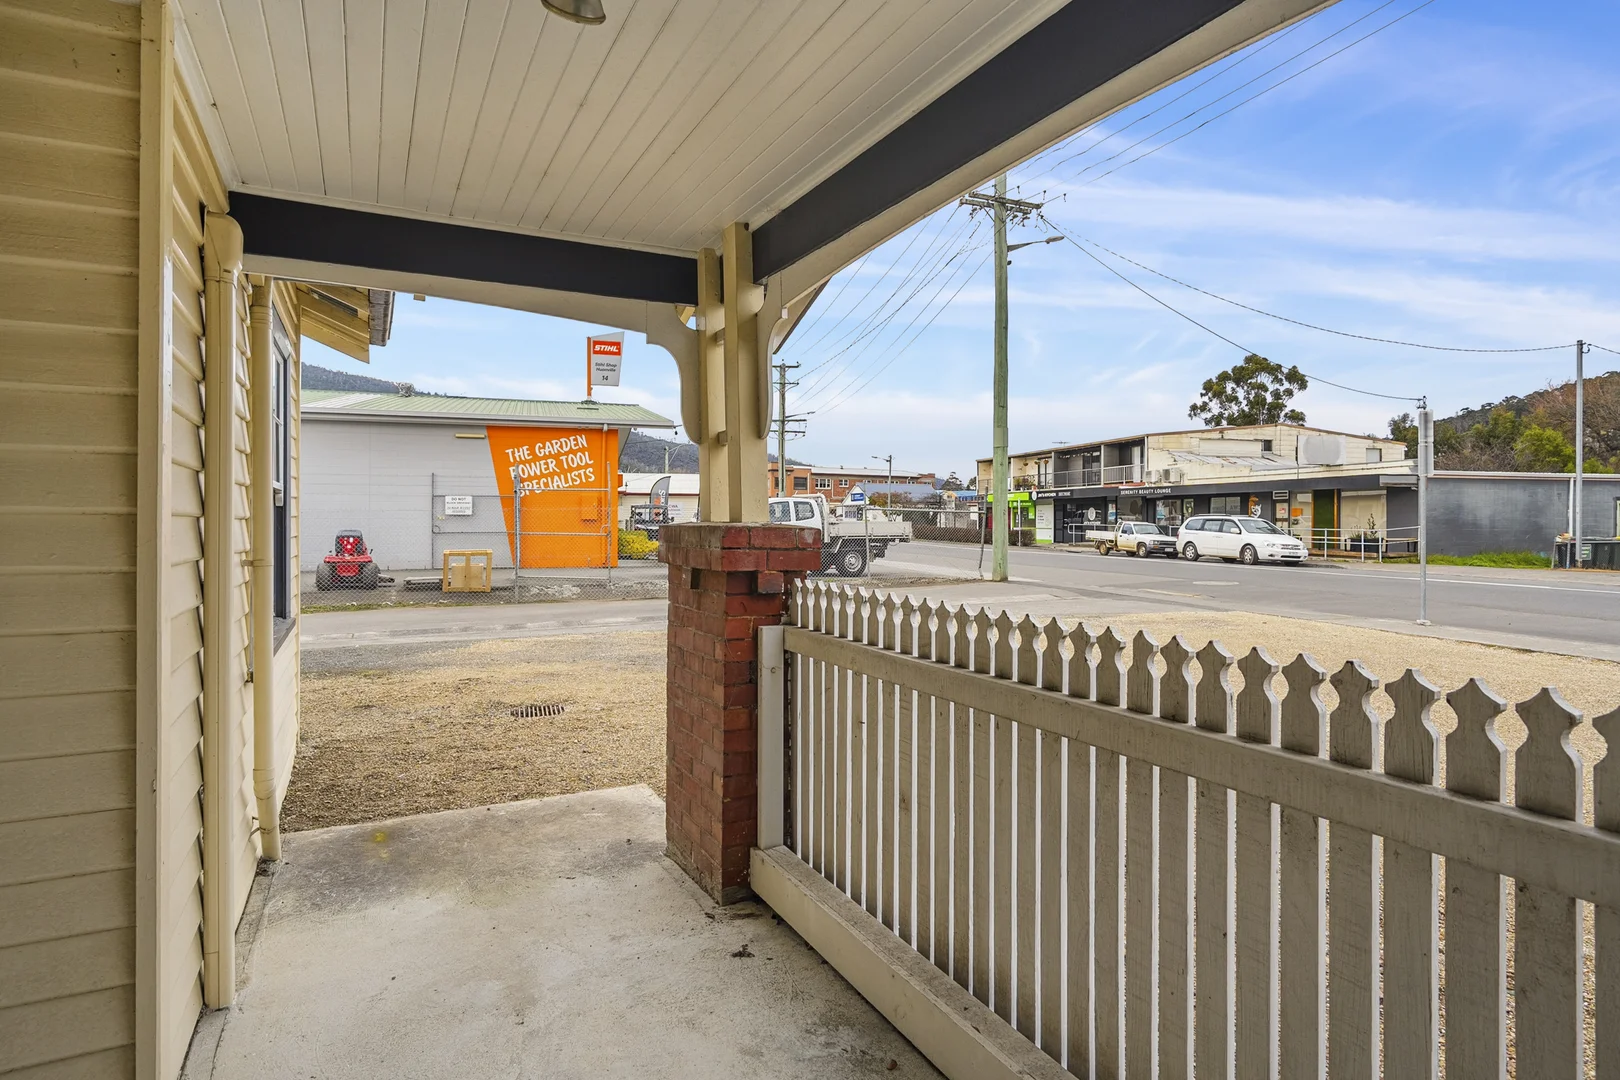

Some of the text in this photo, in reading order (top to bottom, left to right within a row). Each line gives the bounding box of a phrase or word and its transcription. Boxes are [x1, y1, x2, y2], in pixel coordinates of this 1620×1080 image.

[505, 434, 588, 462] THE GARDEN
[508, 451, 594, 480] POWER TOOL
[520, 468, 595, 497] SPECIALISTS
